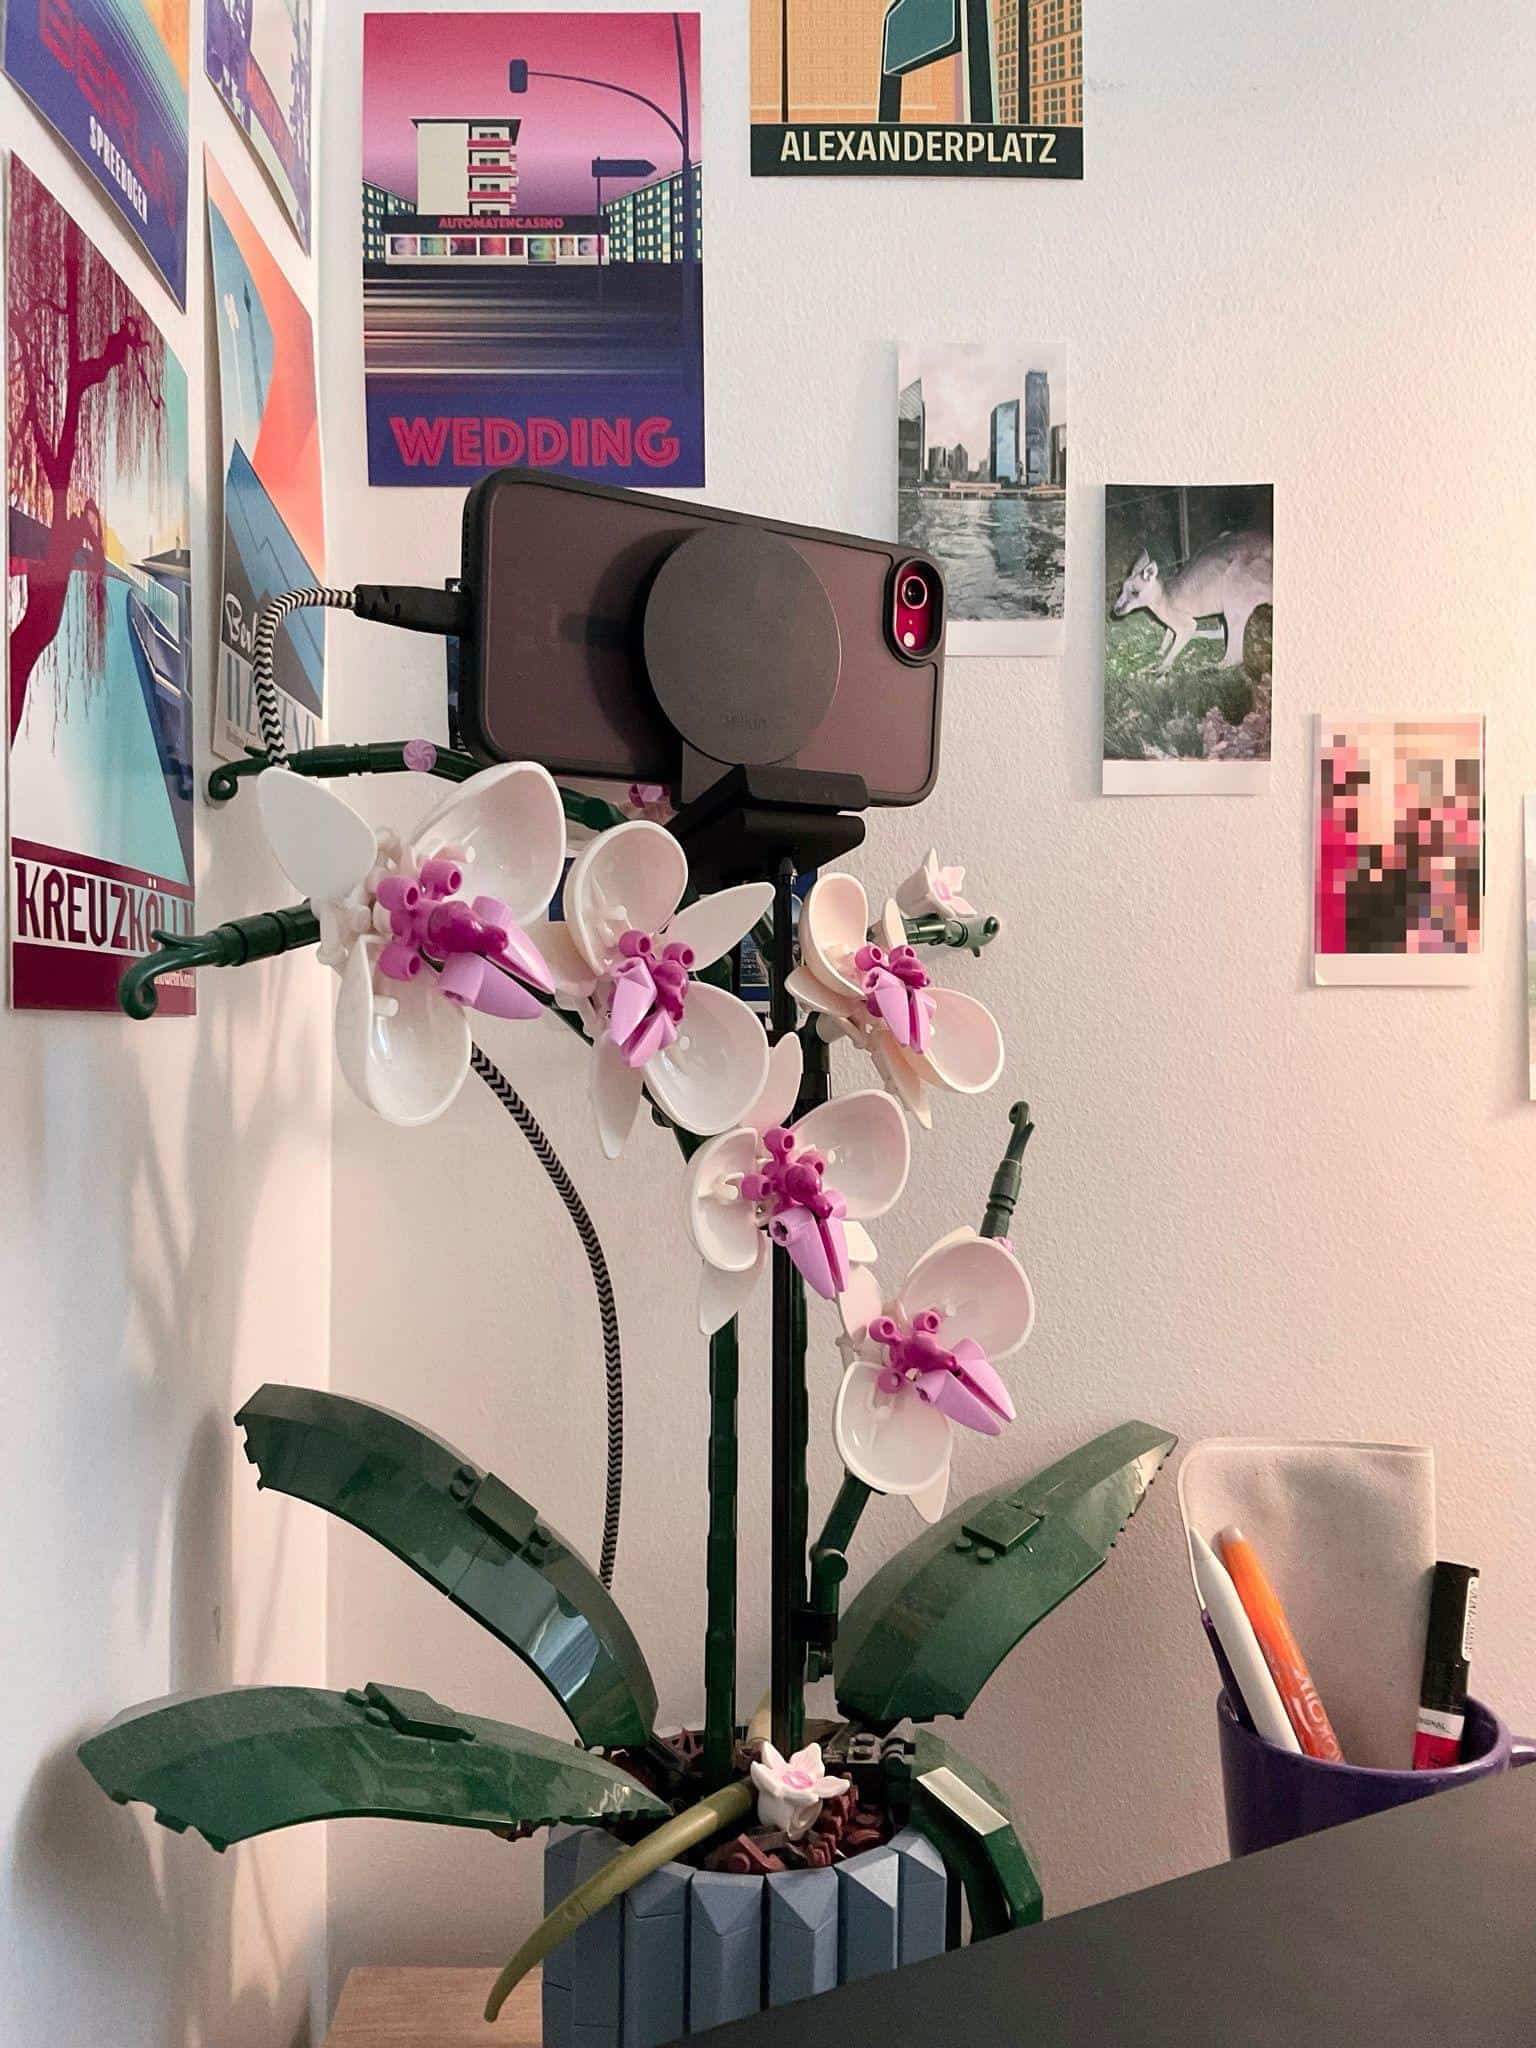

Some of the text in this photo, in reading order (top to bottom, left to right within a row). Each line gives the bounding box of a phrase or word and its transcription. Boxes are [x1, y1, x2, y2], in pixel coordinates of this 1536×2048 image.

[780, 130, 1057, 163] ALEXANDERPLATZ
[390, 416, 680, 468] WEDDING
[225, 592, 258, 656] Berl
